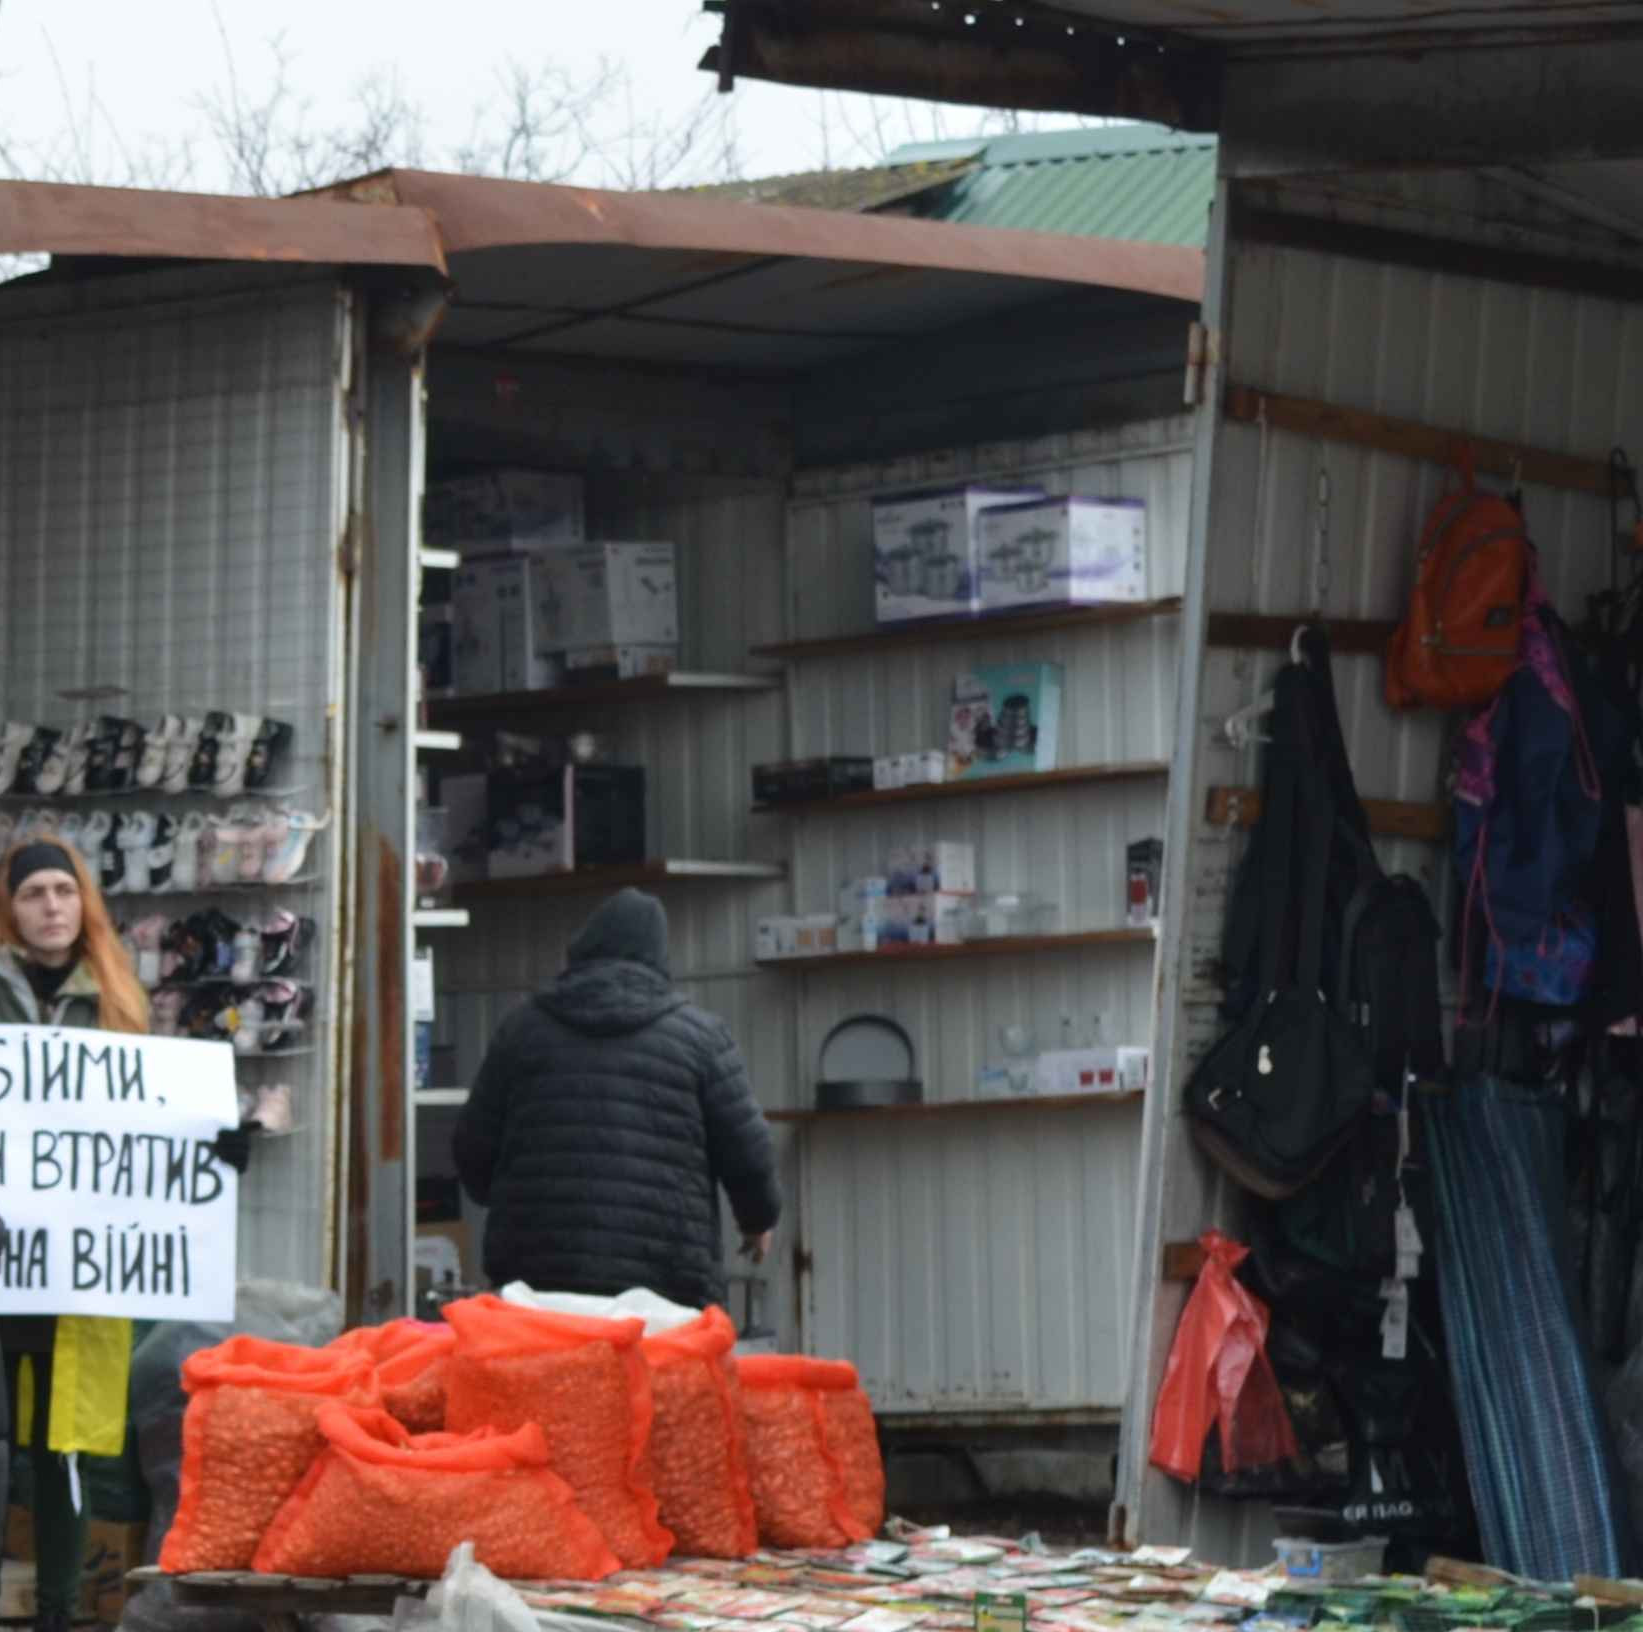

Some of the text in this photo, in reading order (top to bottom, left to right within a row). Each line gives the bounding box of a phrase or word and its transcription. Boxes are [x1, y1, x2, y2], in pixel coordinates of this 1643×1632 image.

[32, 1130, 223, 1205] ВТРАТИВ
[3, 1223, 190, 1297] НА ВІЙНІ
